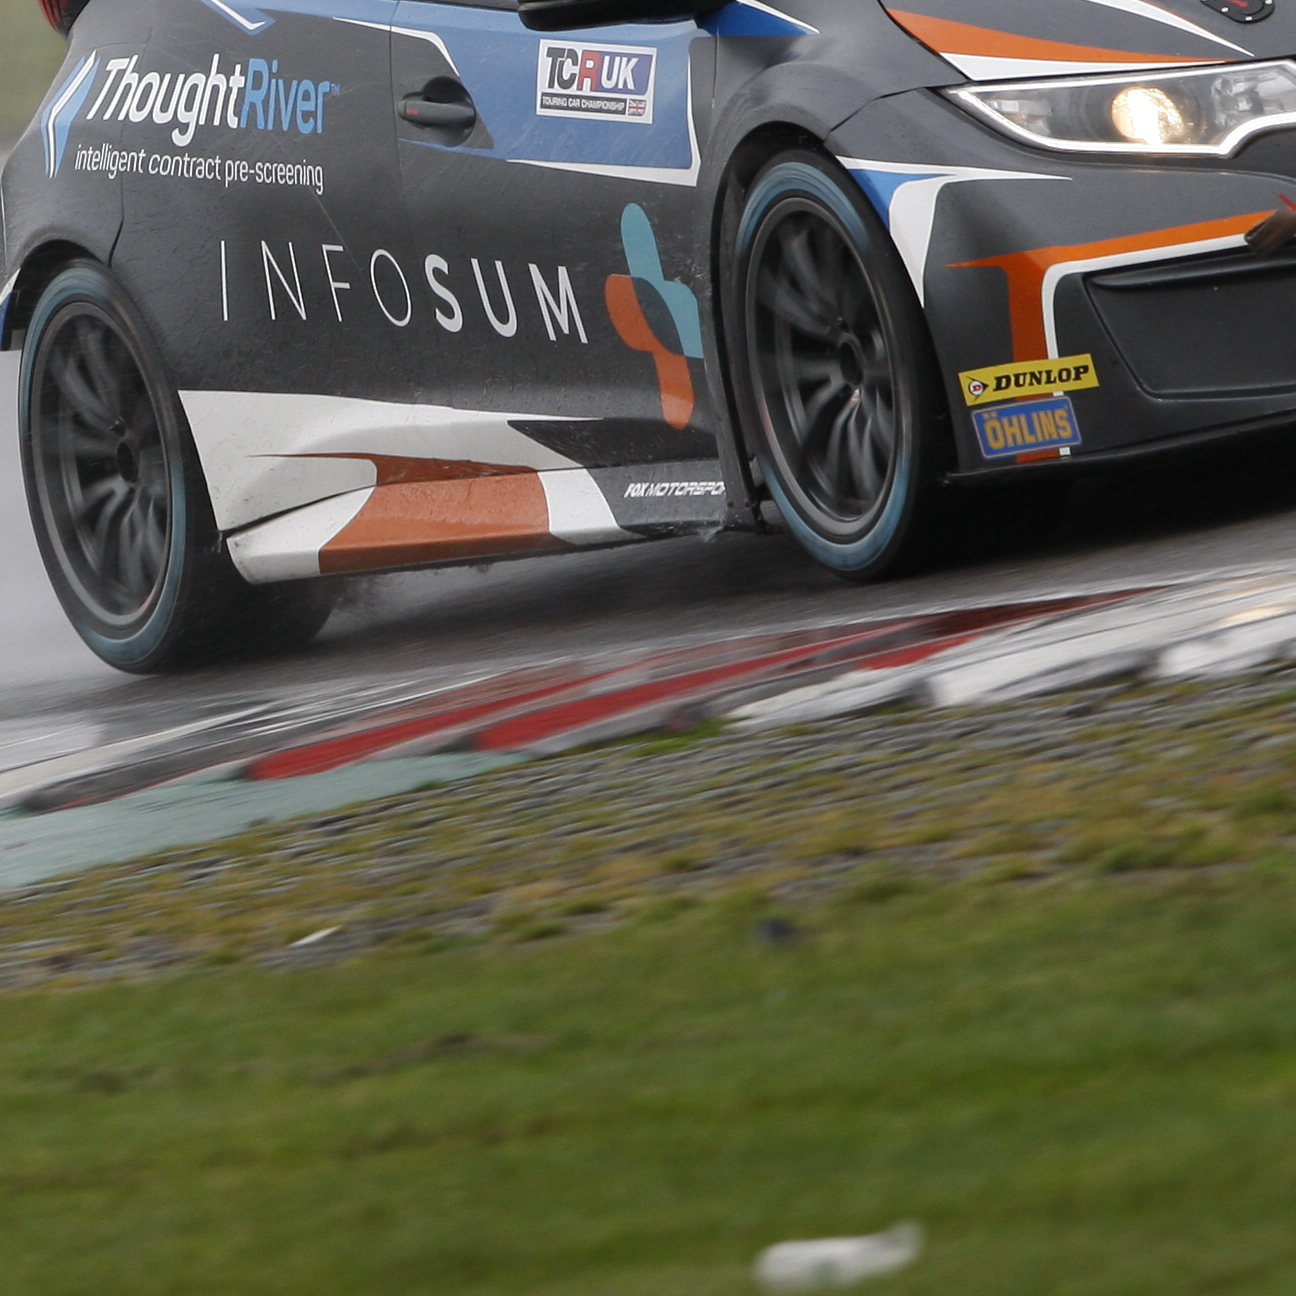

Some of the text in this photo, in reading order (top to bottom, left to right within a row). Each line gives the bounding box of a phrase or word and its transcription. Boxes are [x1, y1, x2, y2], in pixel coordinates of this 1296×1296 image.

[542, 95, 625, 111] TOURING CAR CHAMPIONSHIP
[75, 143, 324, 196] intelligent contract pre-screening
[219, 240, 589, 345] INFOSUM
[993, 365, 1090, 392] DUNLOP
[982, 408, 1073, 450] ÖHLINS
